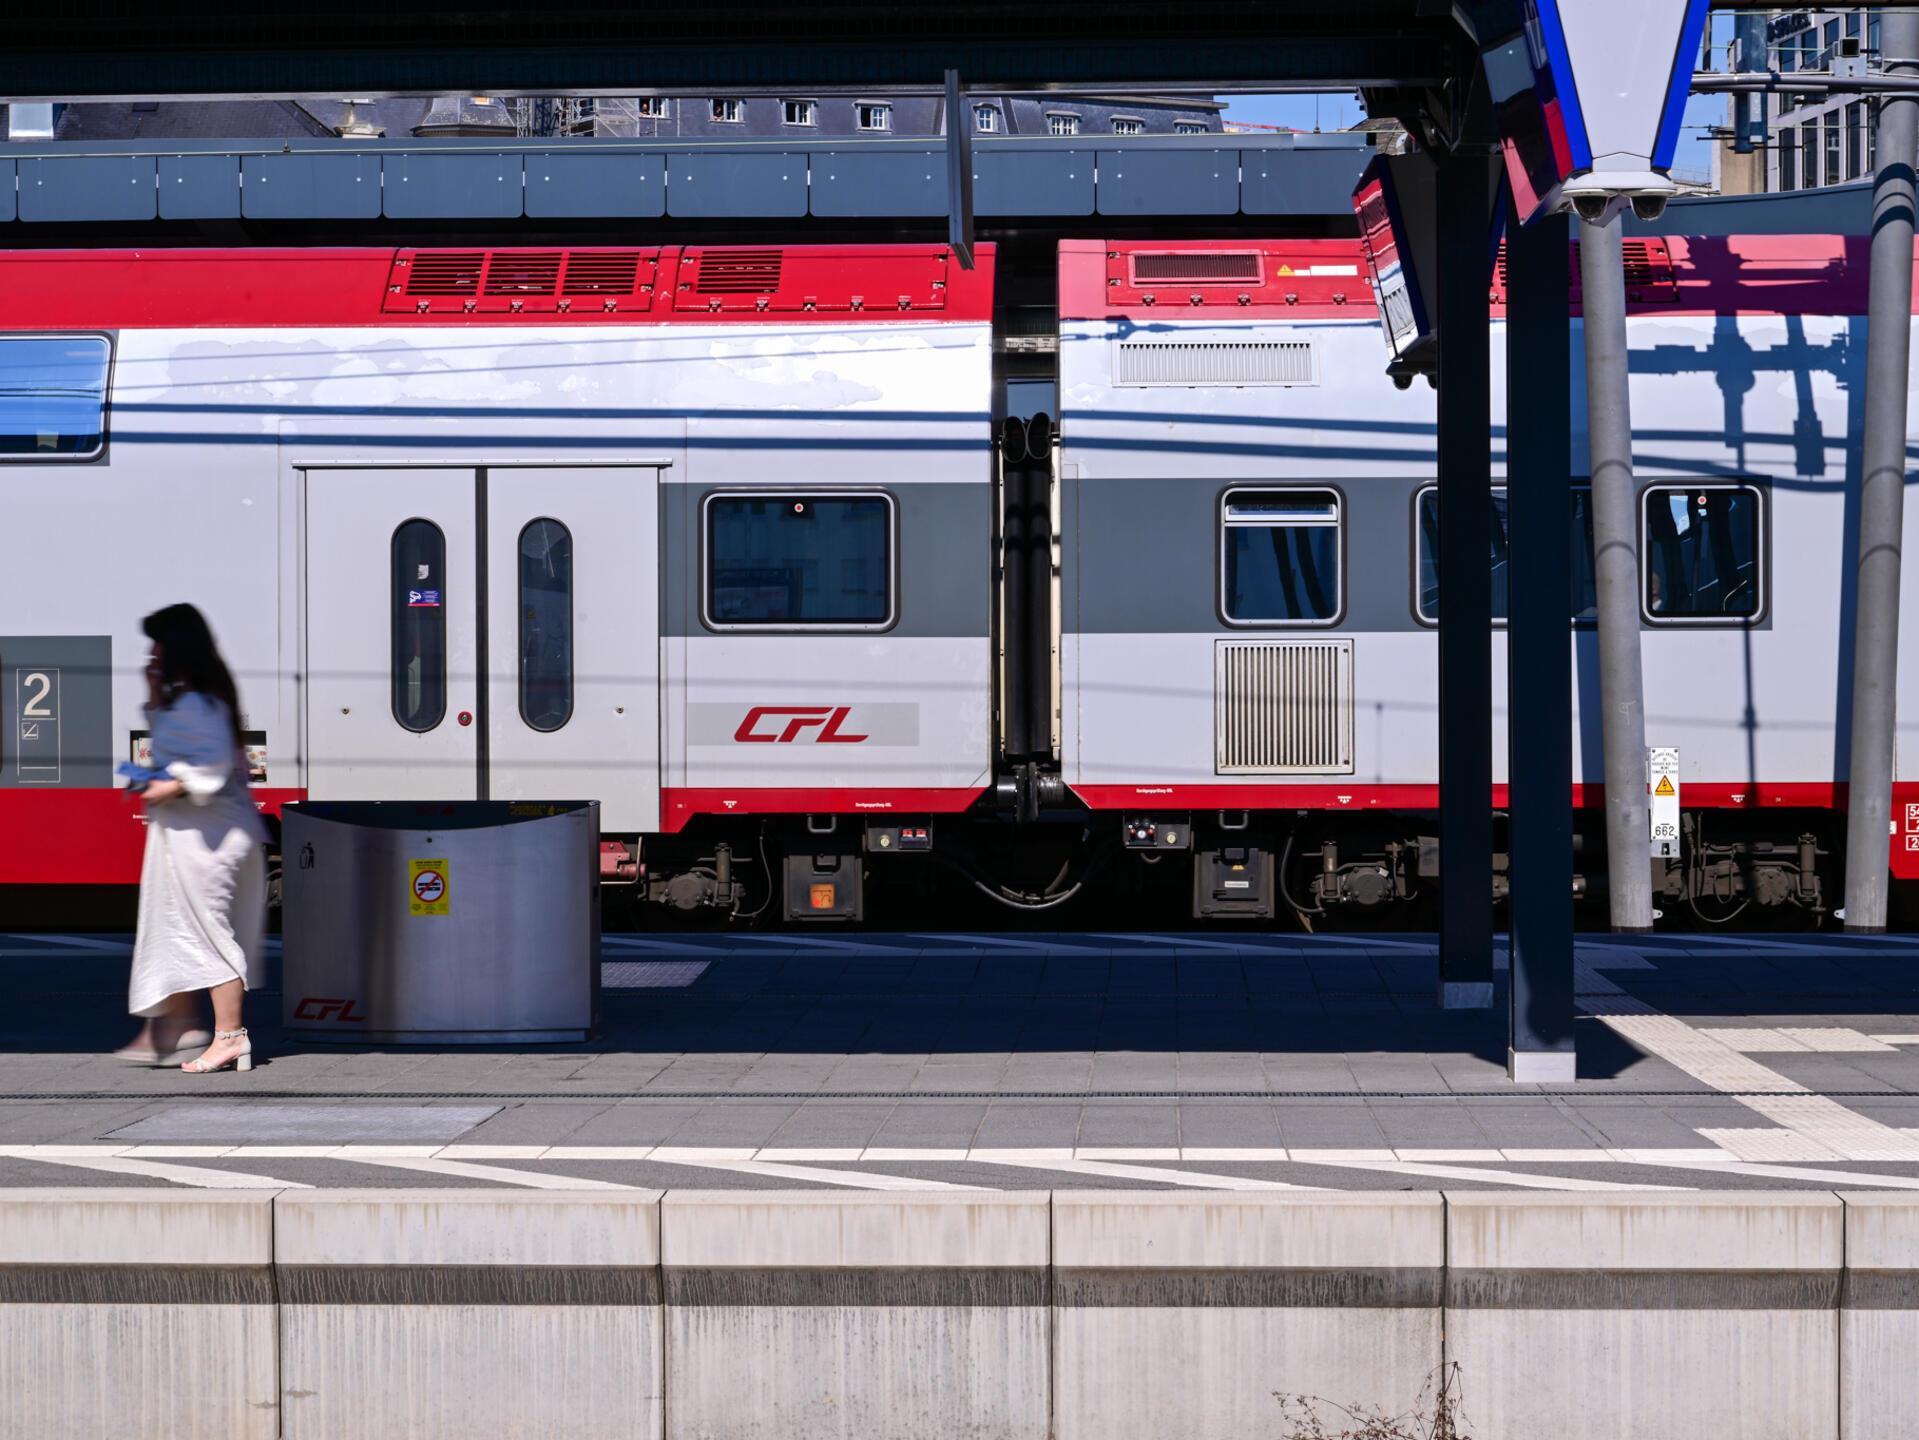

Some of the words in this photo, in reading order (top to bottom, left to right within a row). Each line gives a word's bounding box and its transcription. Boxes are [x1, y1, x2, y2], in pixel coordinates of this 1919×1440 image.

[23, 672, 51, 716] 2
[734, 706, 869, 743] CFL
[1910, 805, 1919, 817] 5
[1655, 825, 1675, 837] 662
[1911, 837, 1919, 849] 2
[293, 997, 367, 1021] CFL
